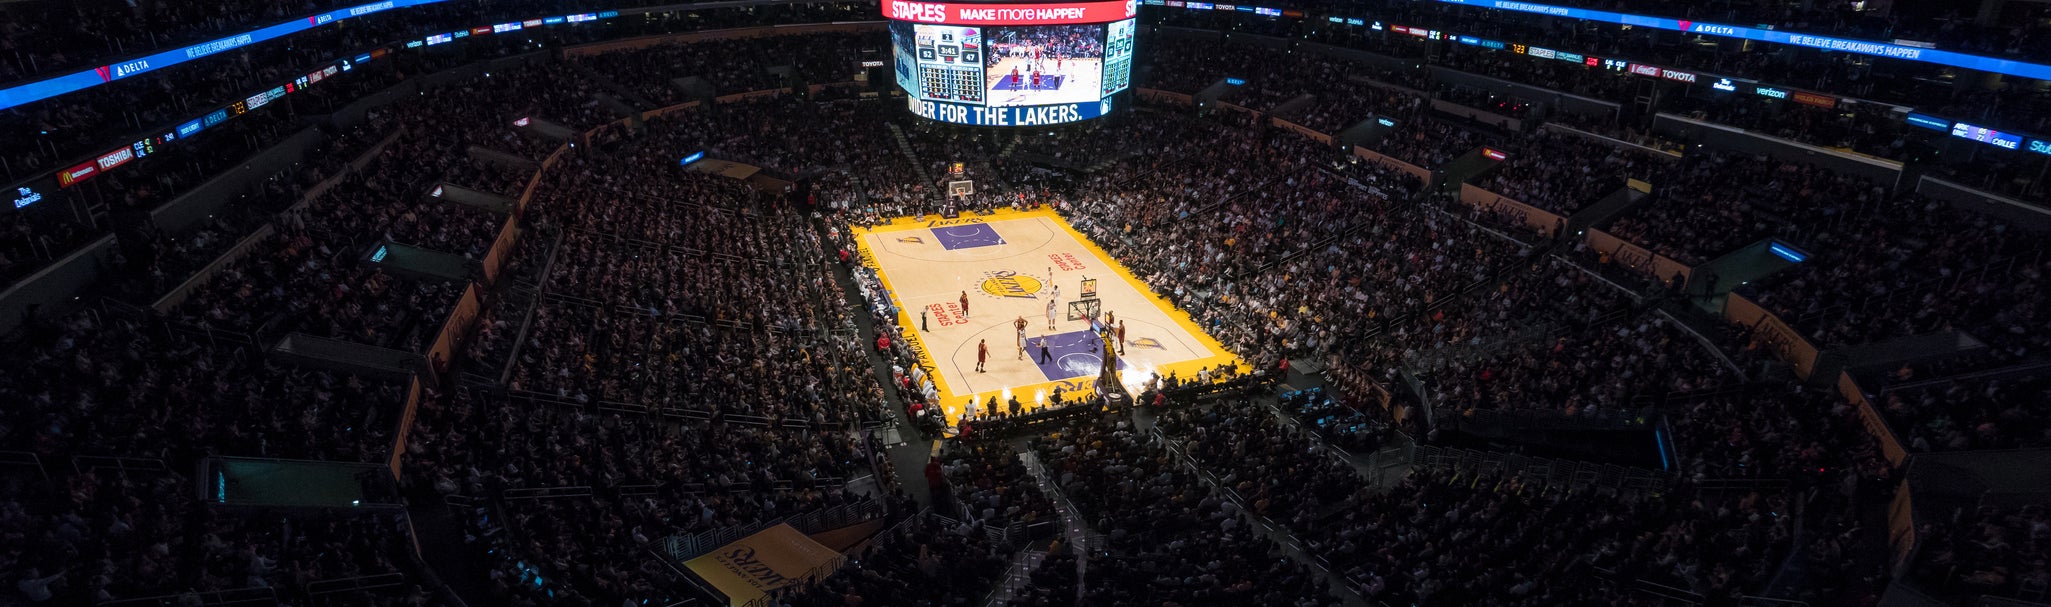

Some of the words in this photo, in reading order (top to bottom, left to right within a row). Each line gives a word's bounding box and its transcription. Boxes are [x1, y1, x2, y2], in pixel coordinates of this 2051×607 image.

[892, 1, 946, 22] STAPLES
[960, 9, 996, 20] MAKE
[998, 9, 1035, 21] more
[1036, 8, 1086, 20] HAPPEN
[1705, 26, 1733, 35] DELTA
[940, 46, 957, 55] 3:41
[1529, 47, 1555, 59] STAPLES
[1789, 34, 1801, 44] WE
[1801, 36, 1831, 48] BELIEVE
[1831, 40, 1884, 55] BREAKAWAYS
[1884, 47, 1921, 59] HAPPEN
[124, 60, 149, 74] DELTA
[1662, 69, 1696, 82] TOYOTA
[1756, 87, 1786, 99] verizon
[940, 103, 967, 123] FOR
[974, 107, 1008, 125] THE
[1015, 104, 1082, 125] LAKERS.
[97, 148, 133, 170] TOSHIBA
[929, 303, 953, 326] STAPLES
[946, 301, 969, 325] Center
